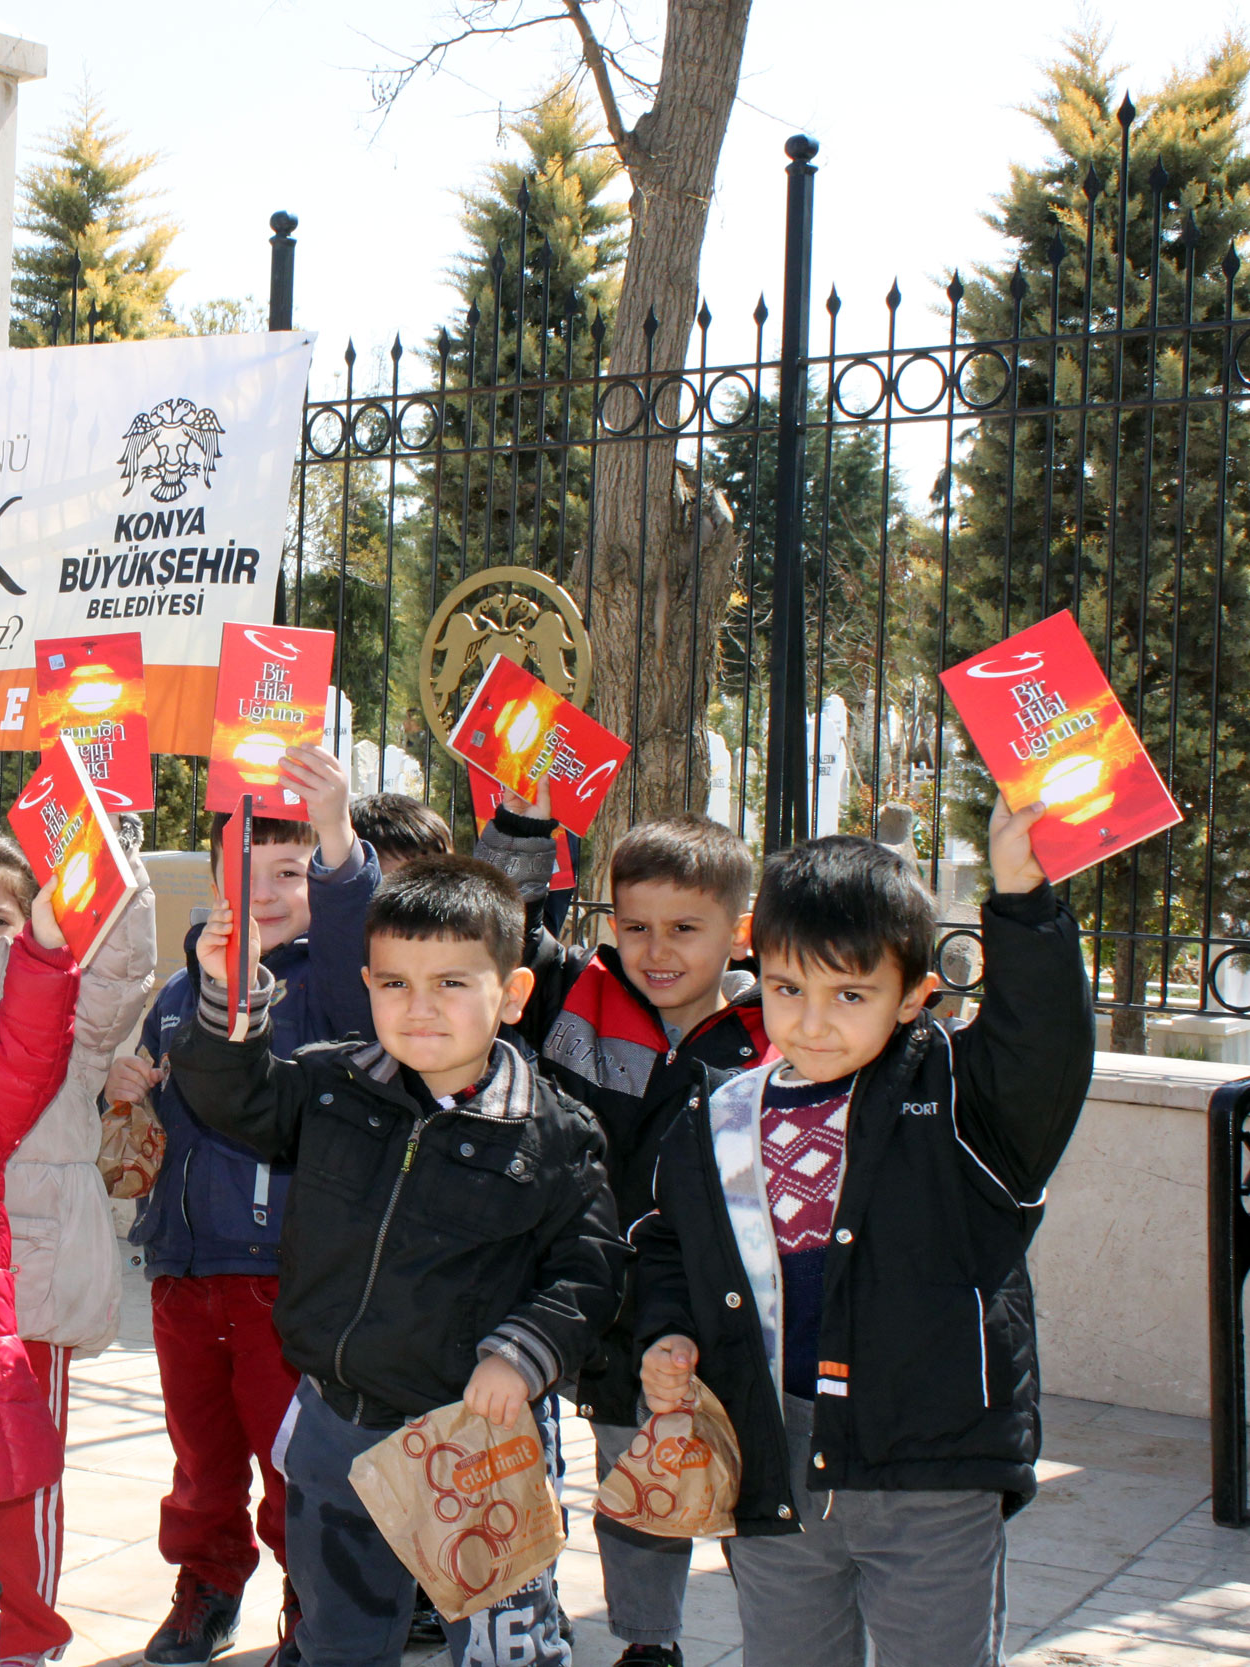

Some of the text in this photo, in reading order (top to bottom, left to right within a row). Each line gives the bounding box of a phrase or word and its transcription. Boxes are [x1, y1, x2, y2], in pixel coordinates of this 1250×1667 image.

[113, 506, 206, 543] KONYA
[58, 539, 261, 593] BÜYÜKŞEHİR
[86, 588, 205, 620] BELEDİYESİ
[261, 661, 291, 683] Bir
[253, 680, 294, 703] Hilâl
[1008, 678, 1047, 709] Bir
[238, 697, 306, 725] Uğruna
[1013, 690, 1070, 734] Hilâl
[1008, 709, 1098, 762] Uğruna
[78, 742, 115, 763] Hilâ
[899, 1101, 940, 1116] PORT
[490, 1597, 516, 1609] NAL
